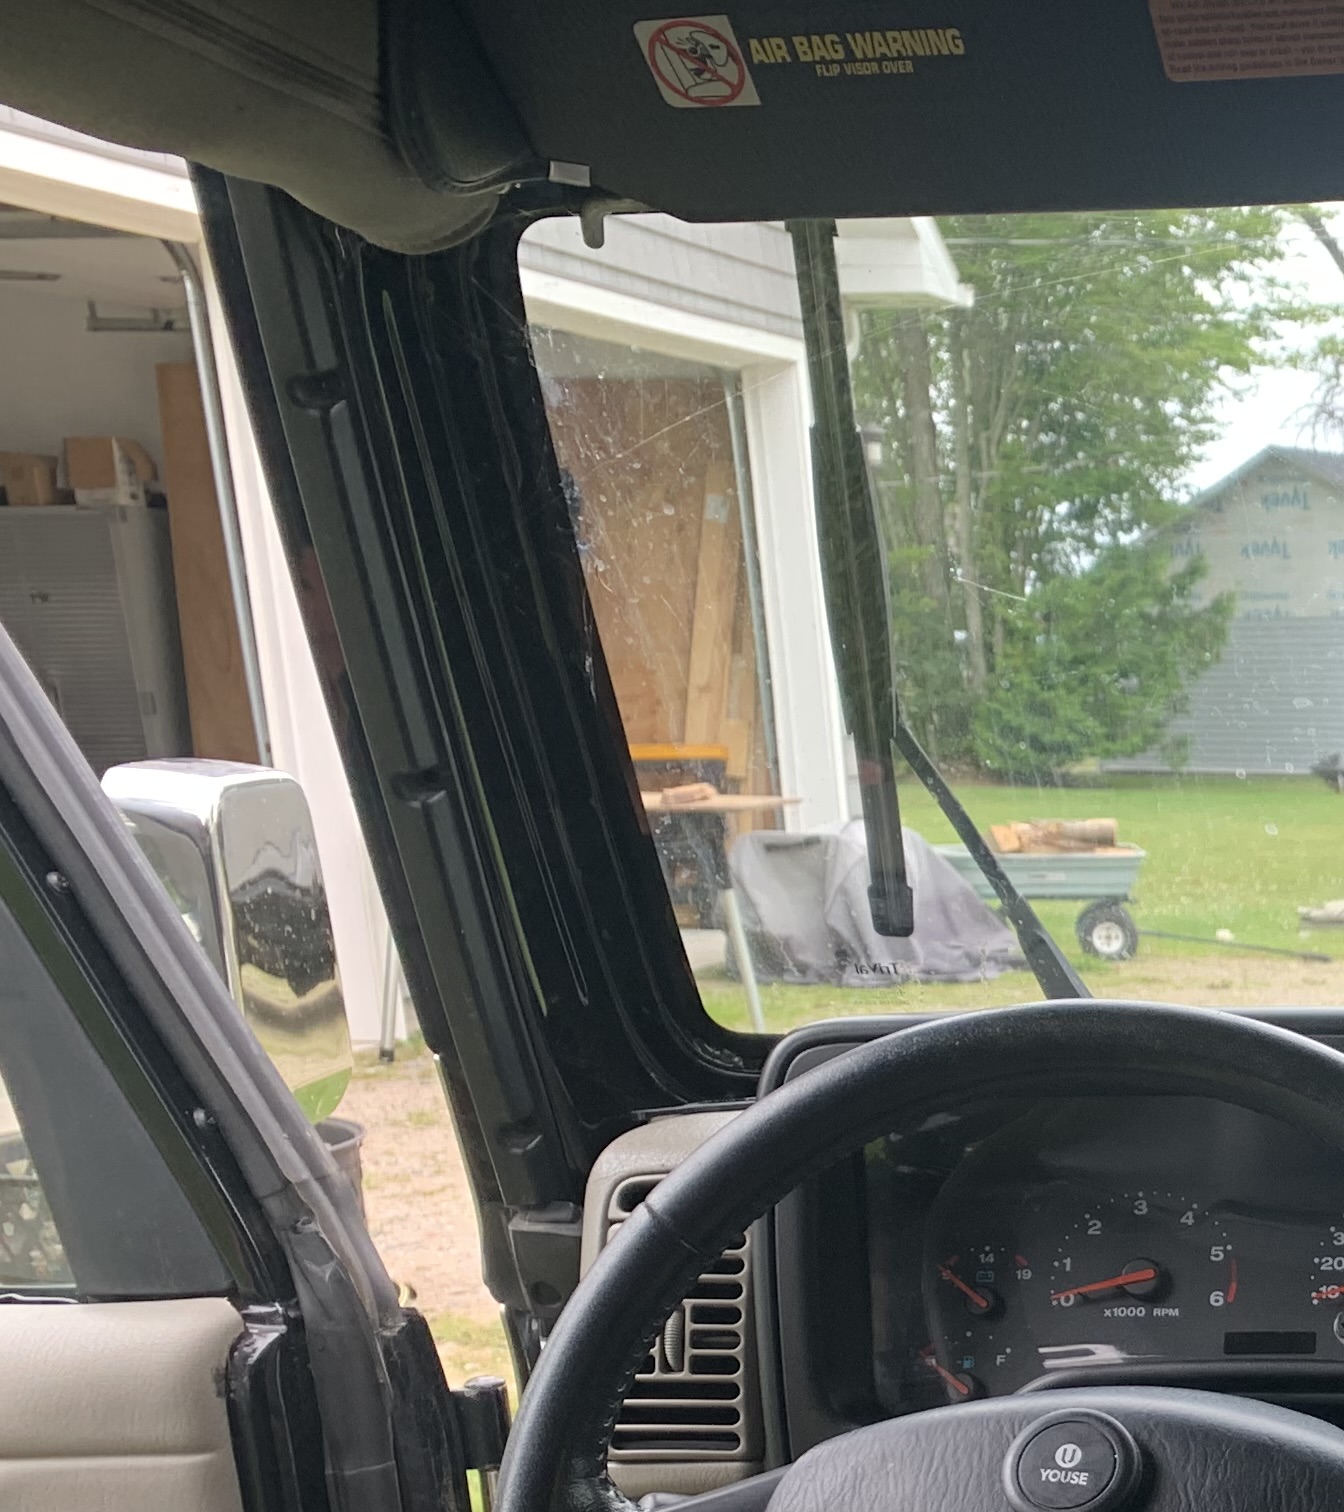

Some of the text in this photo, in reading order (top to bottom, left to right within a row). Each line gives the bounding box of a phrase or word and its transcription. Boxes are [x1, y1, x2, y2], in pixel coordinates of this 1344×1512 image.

[748, 28, 966, 64] AIR BAG WARNING
[815, 60, 914, 77] FLIP VISOR OVER
[1261, 484, 1311, 513] Tyvek
[1241, 535, 1291, 560] Tyvek
[1133, 1200, 1148, 1215] 3
[1180, 1211, 1195, 1226] 4
[1087, 1220, 1102, 1235] 2
[979, 1253, 995, 1263] 14
[1209, 1246, 1225, 1261] 5
[1062, 1257, 1072, 1272] 1
[1016, 1269, 1032, 1280] 19
[1060, 1292, 1075, 1307] 0
[1209, 1291, 1225, 1307] 6
[1103, 1306, 1180, 1317] x1000 RPM
[996, 1355, 1006, 1366] F
[1040, 1468, 1089, 1485] YOUSE
